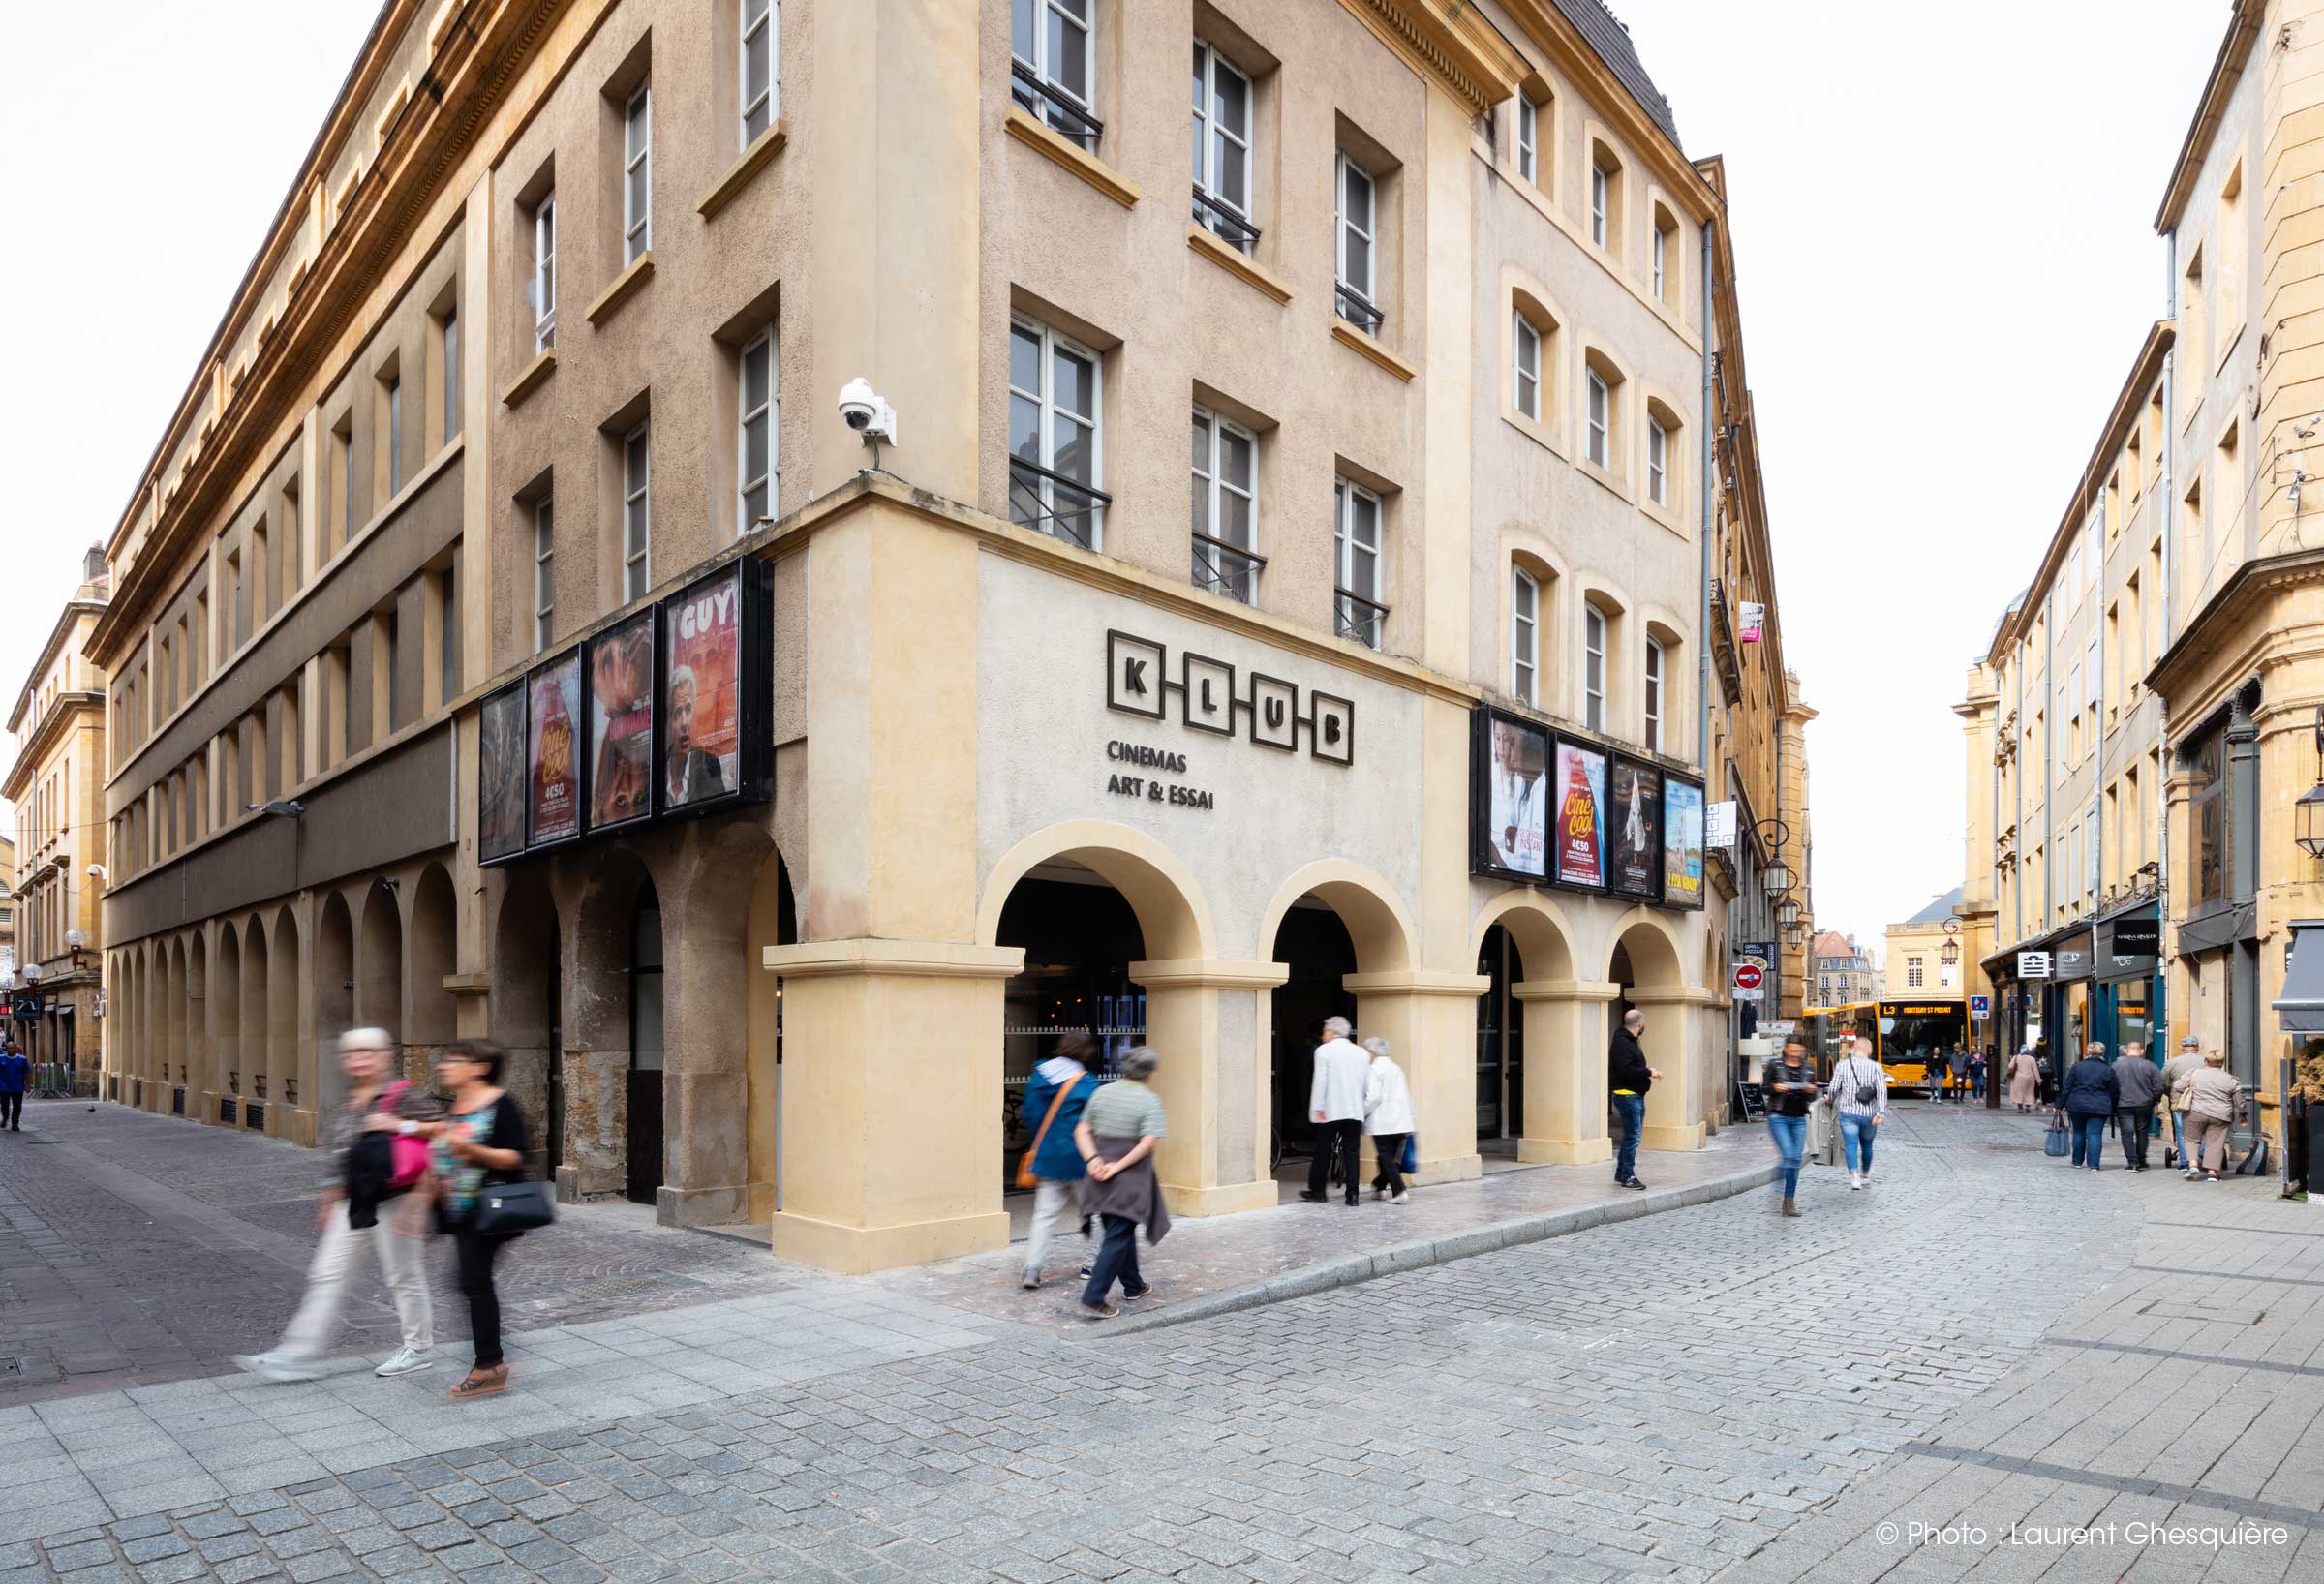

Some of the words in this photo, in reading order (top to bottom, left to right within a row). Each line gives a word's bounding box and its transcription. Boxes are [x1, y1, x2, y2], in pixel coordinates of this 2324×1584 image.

[680, 587, 733, 640] GUY
[1126, 656, 1341, 744] KLUB
[1107, 740, 1187, 773] CINEMAS
[1107, 774, 1145, 798] ART
[1147, 781, 1165, 802] &
[1169, 784, 1214, 810] ESSAI
[1883, 1006, 1895, 1015] L3
